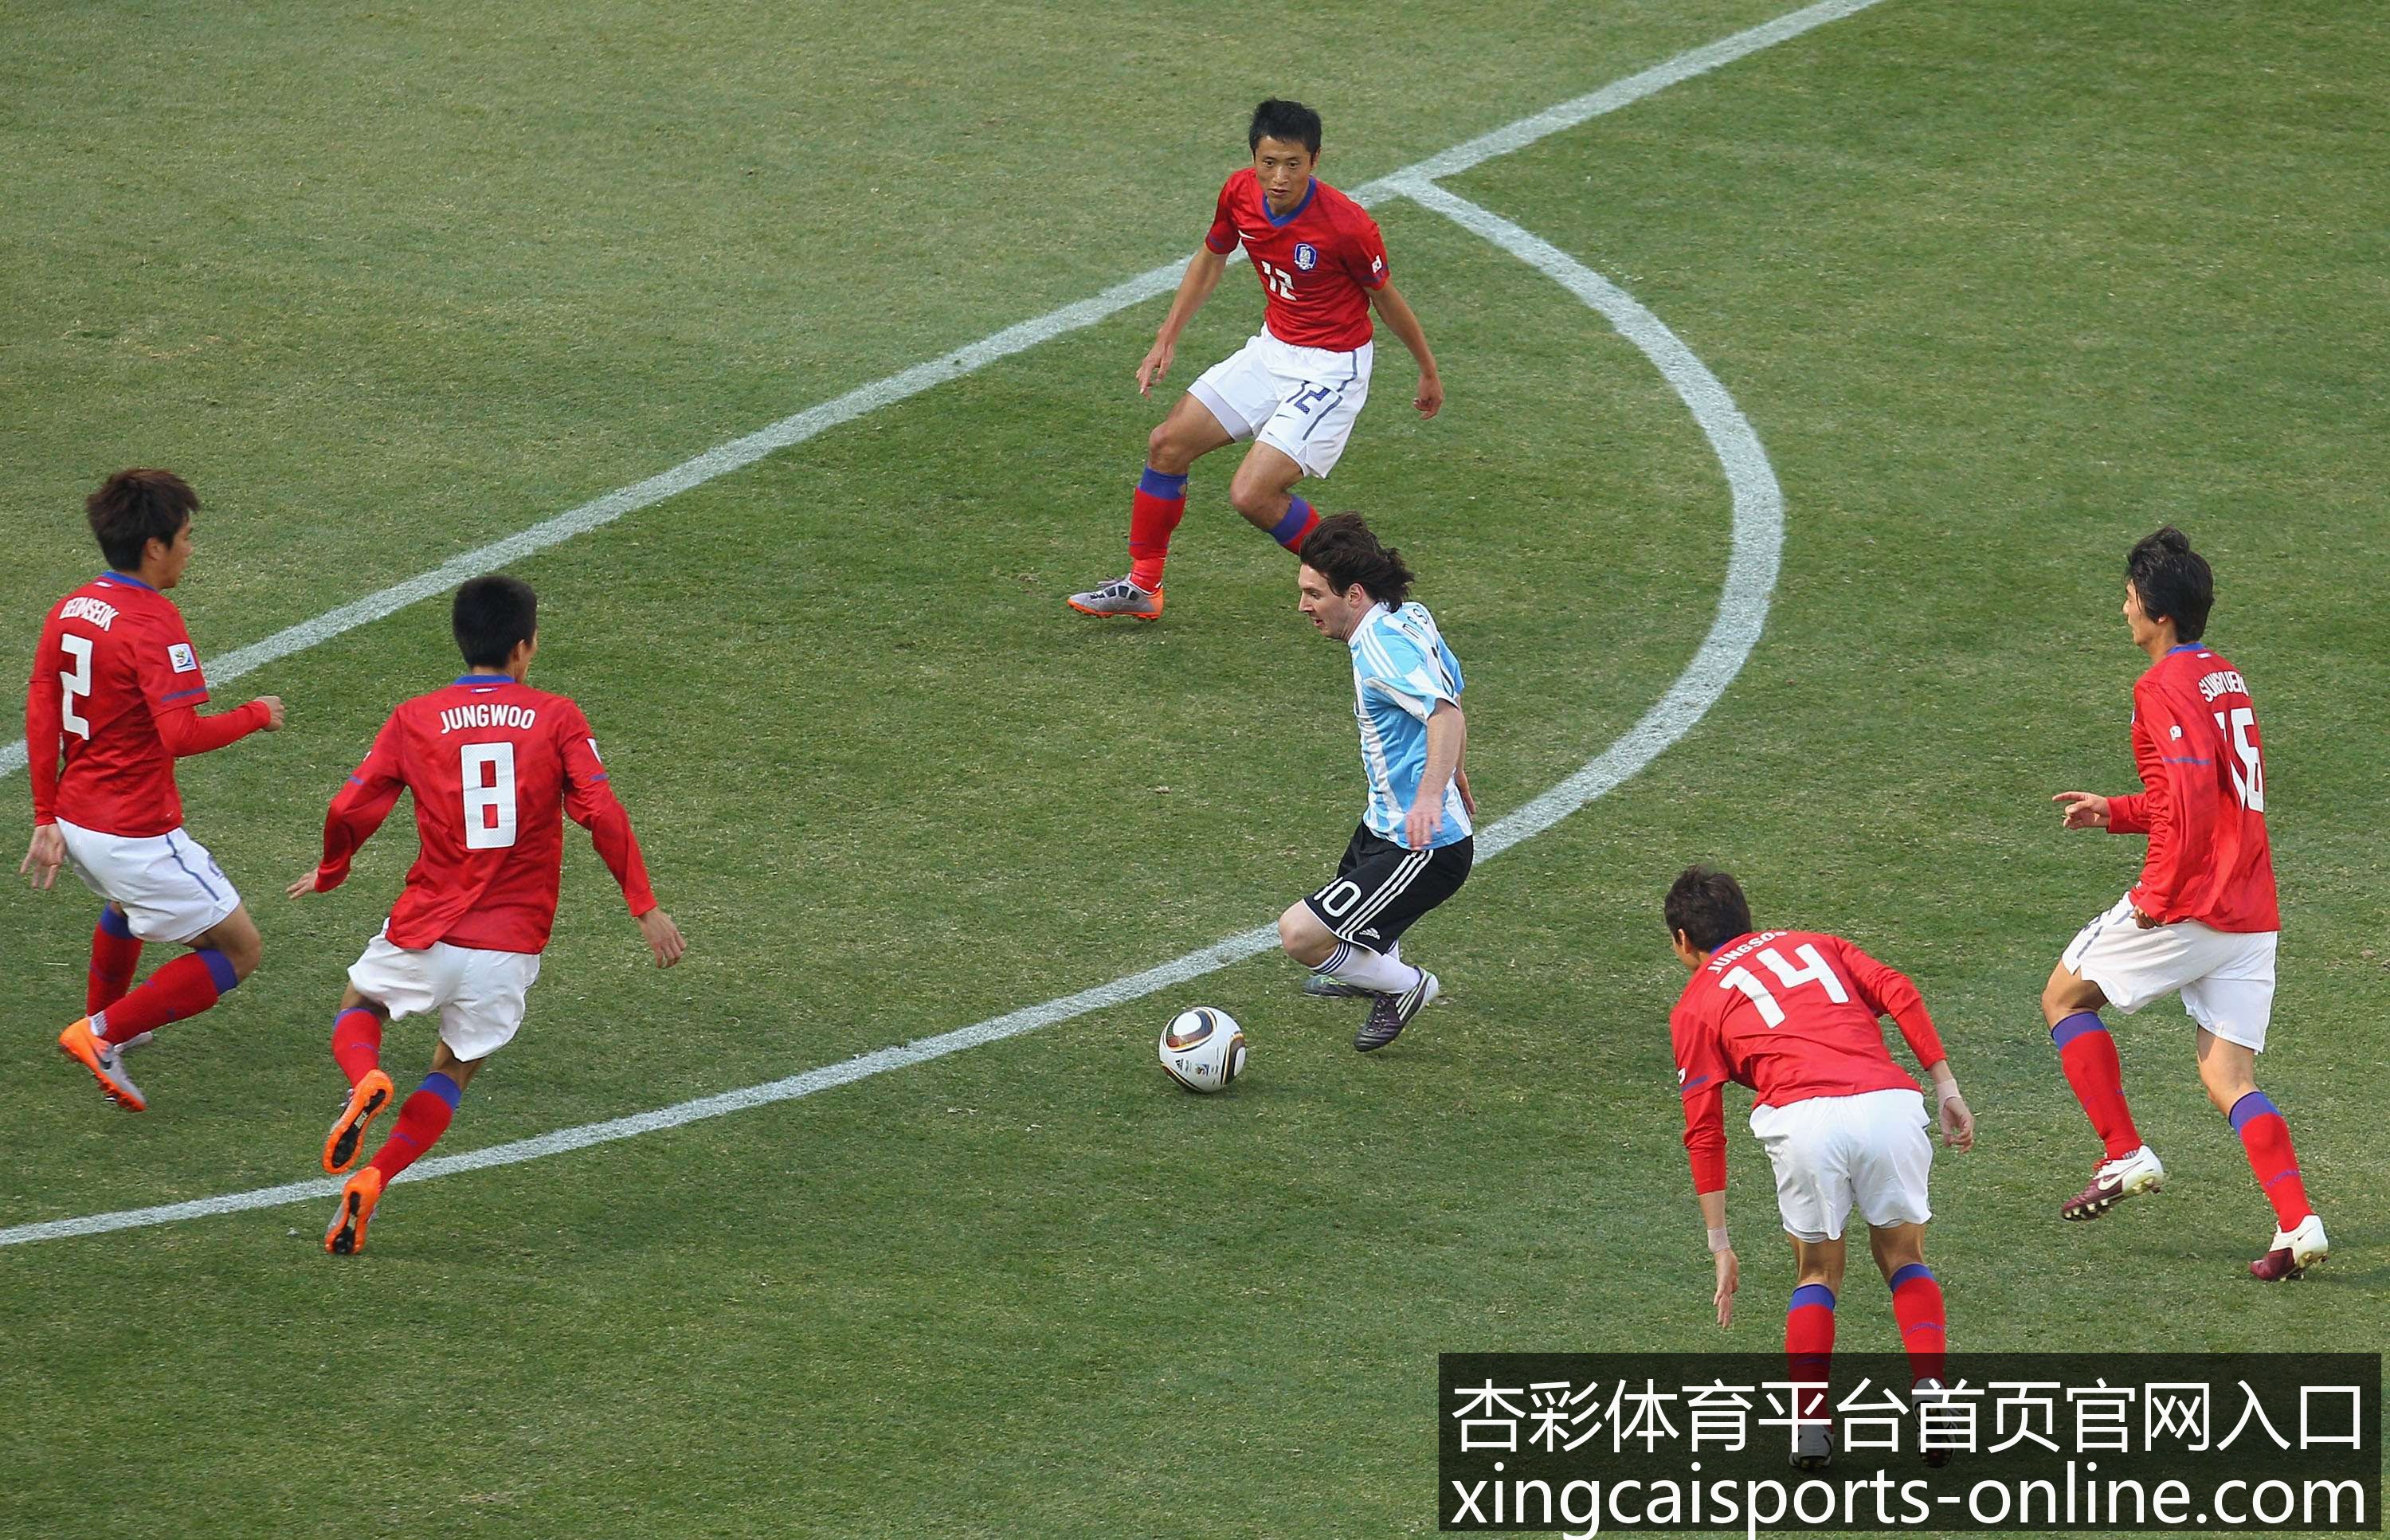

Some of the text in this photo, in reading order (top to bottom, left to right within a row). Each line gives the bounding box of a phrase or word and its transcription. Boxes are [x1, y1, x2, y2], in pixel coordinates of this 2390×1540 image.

[1261, 261, 1297, 301] 12
[1286, 380, 1332, 415] 12
[59, 633, 94, 741] 2
[440, 703, 536, 735] JUNGWOO
[2212, 707, 2265, 813] 16
[460, 741, 518, 850] 8
[1313, 876, 1362, 918] 10
[1718, 942, 1851, 1030] 14
